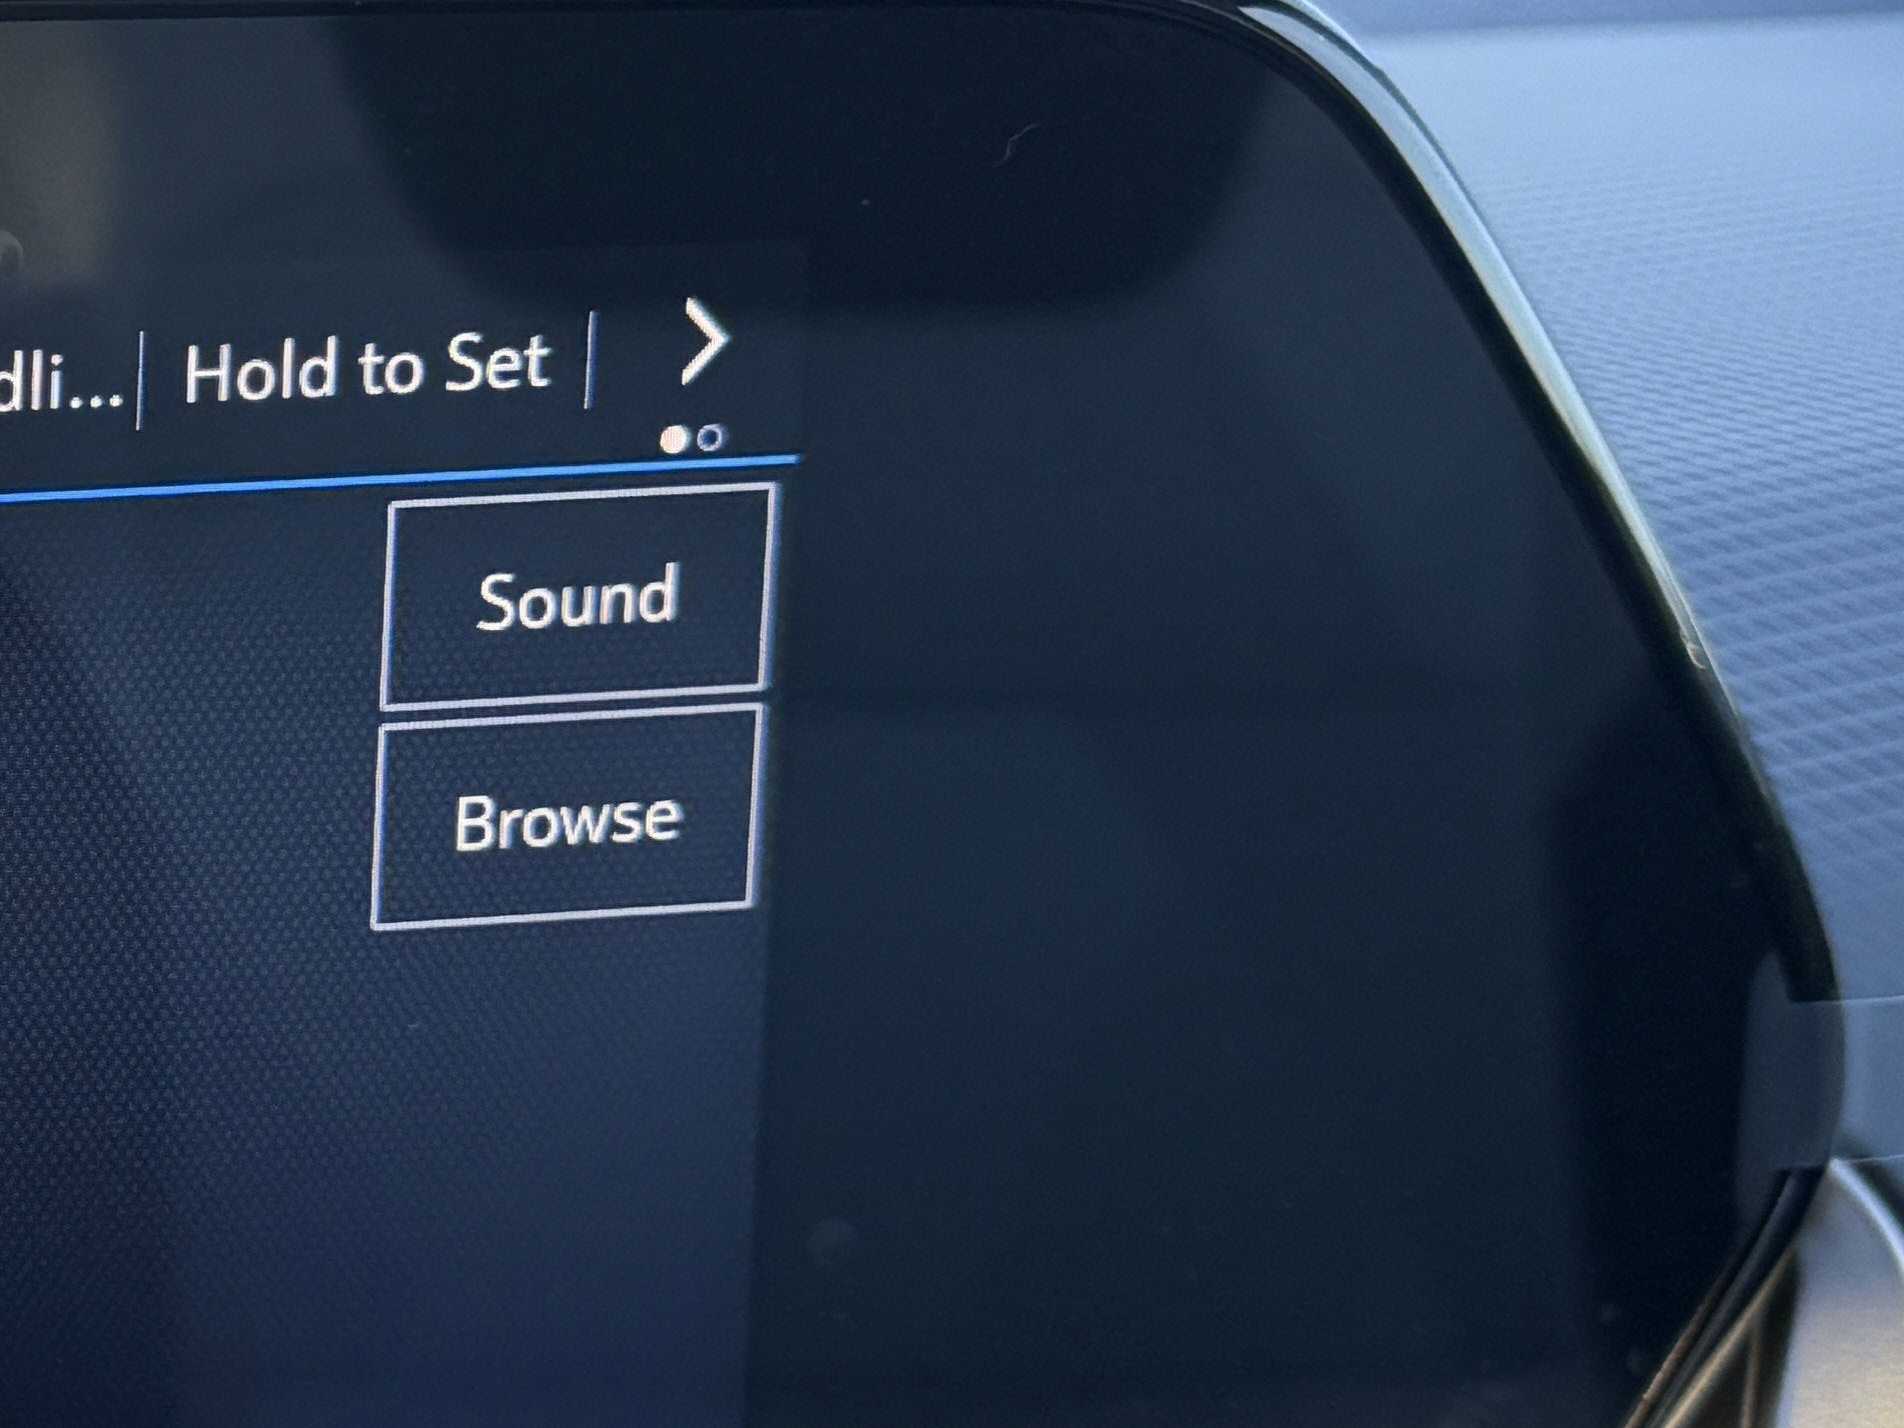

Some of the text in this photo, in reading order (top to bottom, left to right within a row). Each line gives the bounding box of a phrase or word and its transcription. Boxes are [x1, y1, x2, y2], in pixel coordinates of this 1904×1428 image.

[185, 331, 553, 404] Hold to Set
[475, 562, 681, 633] Sound
[455, 795, 686, 853] Browse
